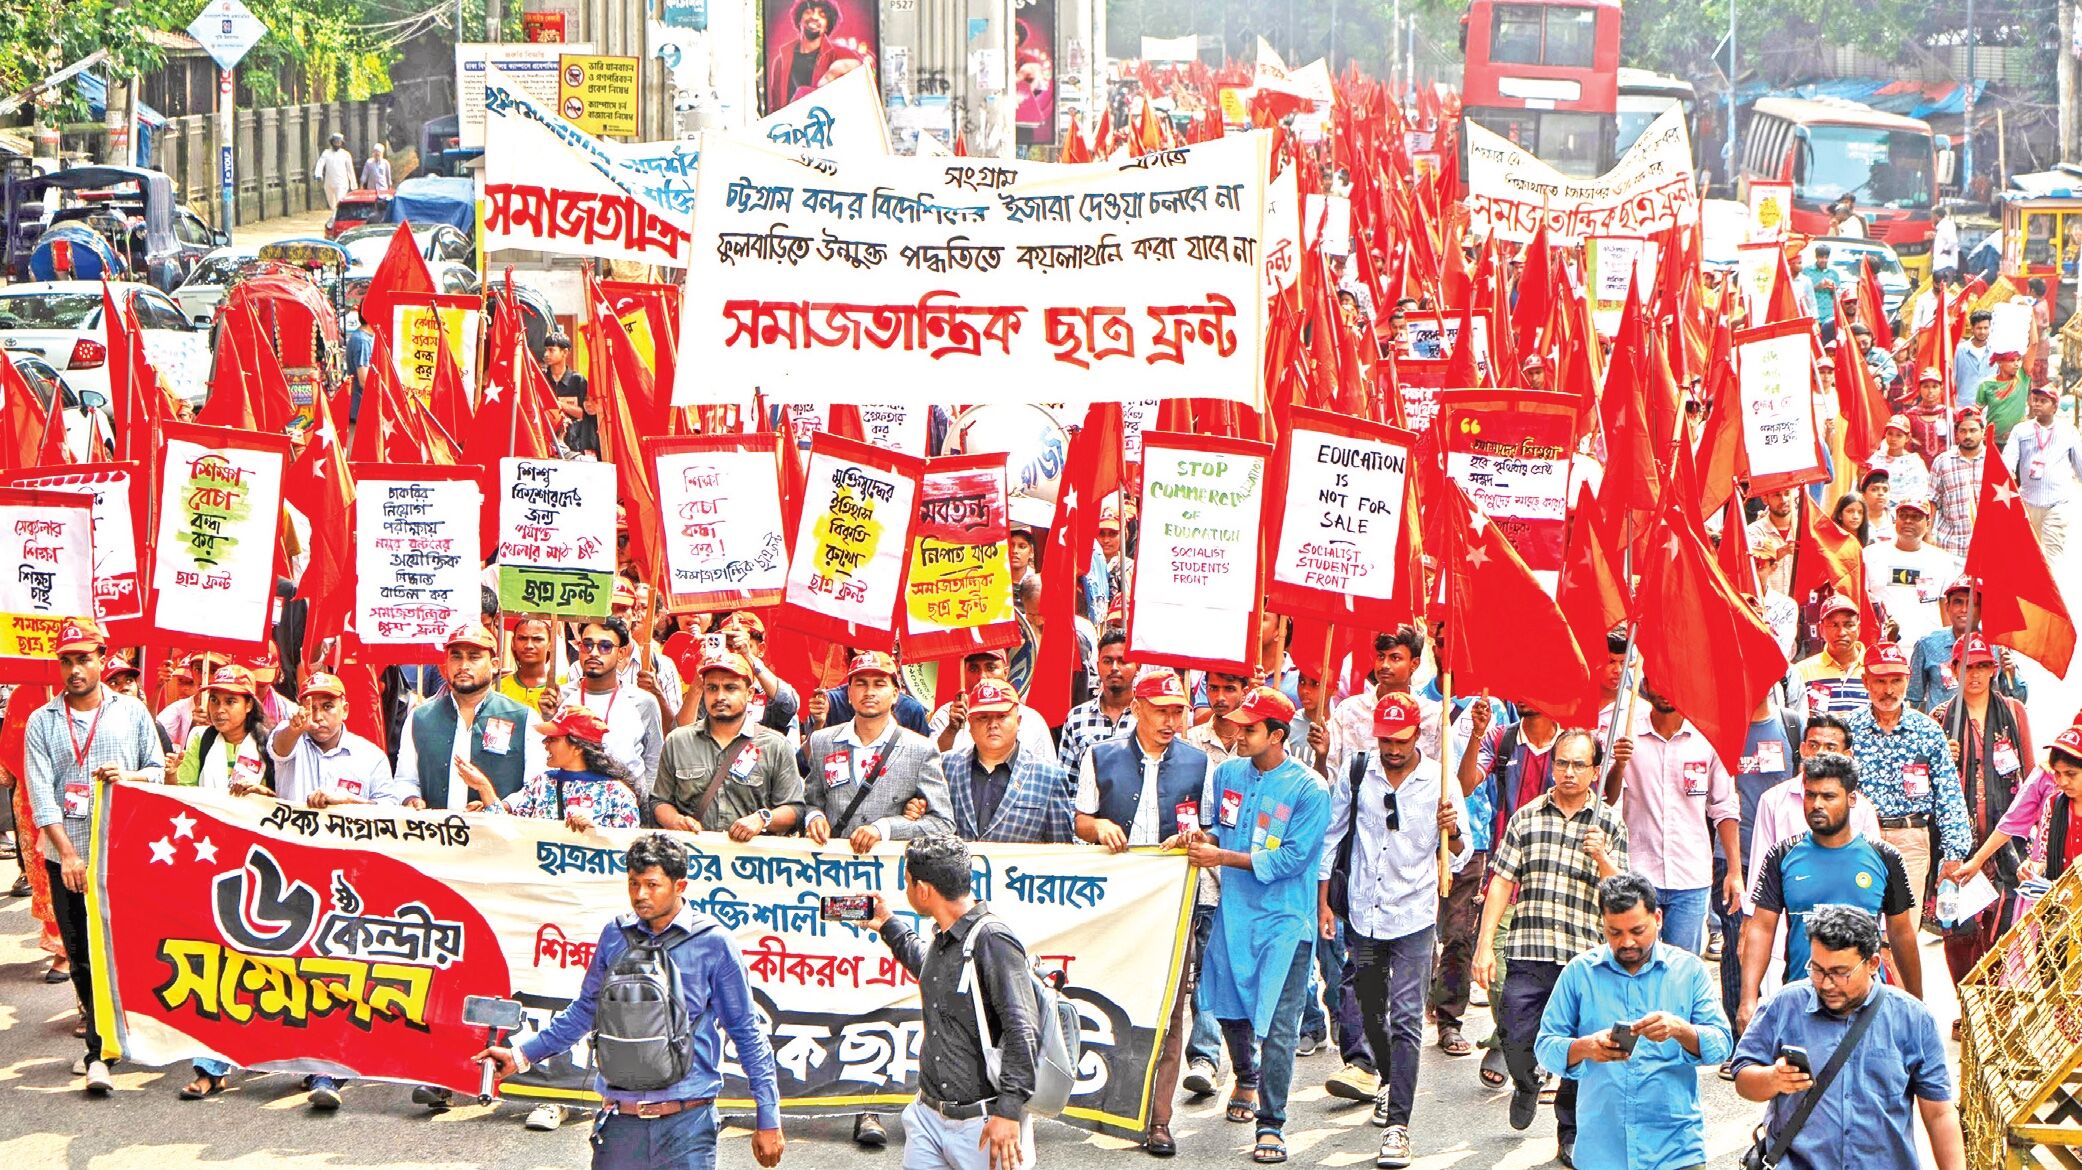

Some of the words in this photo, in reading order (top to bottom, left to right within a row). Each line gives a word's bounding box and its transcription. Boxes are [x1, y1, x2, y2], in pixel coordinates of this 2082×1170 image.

[944, 166, 1018, 193] সংগ্রাম
[726, 176, 794, 213] চট্টগ্রাম
[802, 188, 868, 221] বন্দর
[998, 193, 1075, 223] ইজারা
[1079, 191, 1145, 225] দেওয়া
[1149, 185, 1208, 214] চলবে
[1215, 183, 1245, 212] না
[717, 222, 815, 266] ফুলবাড়িতে
[816, 227, 888, 269] উন্মুক্ত
[899, 235, 1005, 273] পদ্ধতিতে
[1016, 233, 1124, 274] কয়লাখনি
[1132, 236, 1178, 262] করা
[1184, 235, 1230, 263] যাবে
[1233, 236, 1258, 267] না
[722, 290, 1029, 360] সমাজতান্ত্রিক
[1044, 305, 1135, 369] ছাত্র
[1147, 292, 1238, 366] ফ্রন্ট
[415, 364, 435, 377] কর
[186, 454, 257, 487] শিক্ষা
[1177, 460, 1229, 478] STOP
[1317, 444, 1406, 474] EDUCATION
[516, 461, 558, 488] শিশু
[1335, 473, 1349, 487] IS
[188, 486, 241, 511] বেচা
[383, 501, 433, 519] নিয়োগ
[829, 490, 873, 521] ইতিহাস
[1318, 489, 1349, 508] NOT
[1358, 497, 1391, 515] FOR
[524, 507, 561, 525] জন্য
[1182, 510, 1201, 521] OF
[1319, 511, 1369, 534] SALE
[191, 531, 229, 556] কর
[828, 517, 871, 546] বিকৃতি
[1164, 522, 1241, 542] EDUCATION
[23, 539, 64, 564] শিক্ষা
[500, 541, 541, 563] খেলার
[920, 535, 965, 567] নিপাত
[970, 541, 999, 564] যাক
[1171, 546, 1226, 560] SOCIALIST
[1298, 542, 1361, 563] SOCIALIST
[521, 578, 555, 607] ছাত্র
[556, 574, 600, 607] ফ্রন্ট
[1173, 573, 1209, 586] FRONT
[1304, 571, 1350, 589] FRONT
[428, 588, 454, 603] কর
[259, 801, 320, 838] ঐক্য
[325, 813, 399, 842] সংগ্রাম
[402, 814, 471, 847] প্রগতি
[1004, 865, 1108, 909] ধারাকে
[313, 900, 465, 969] কেন্দ্রীয়
[154, 936, 434, 1034] সম্মেলন
